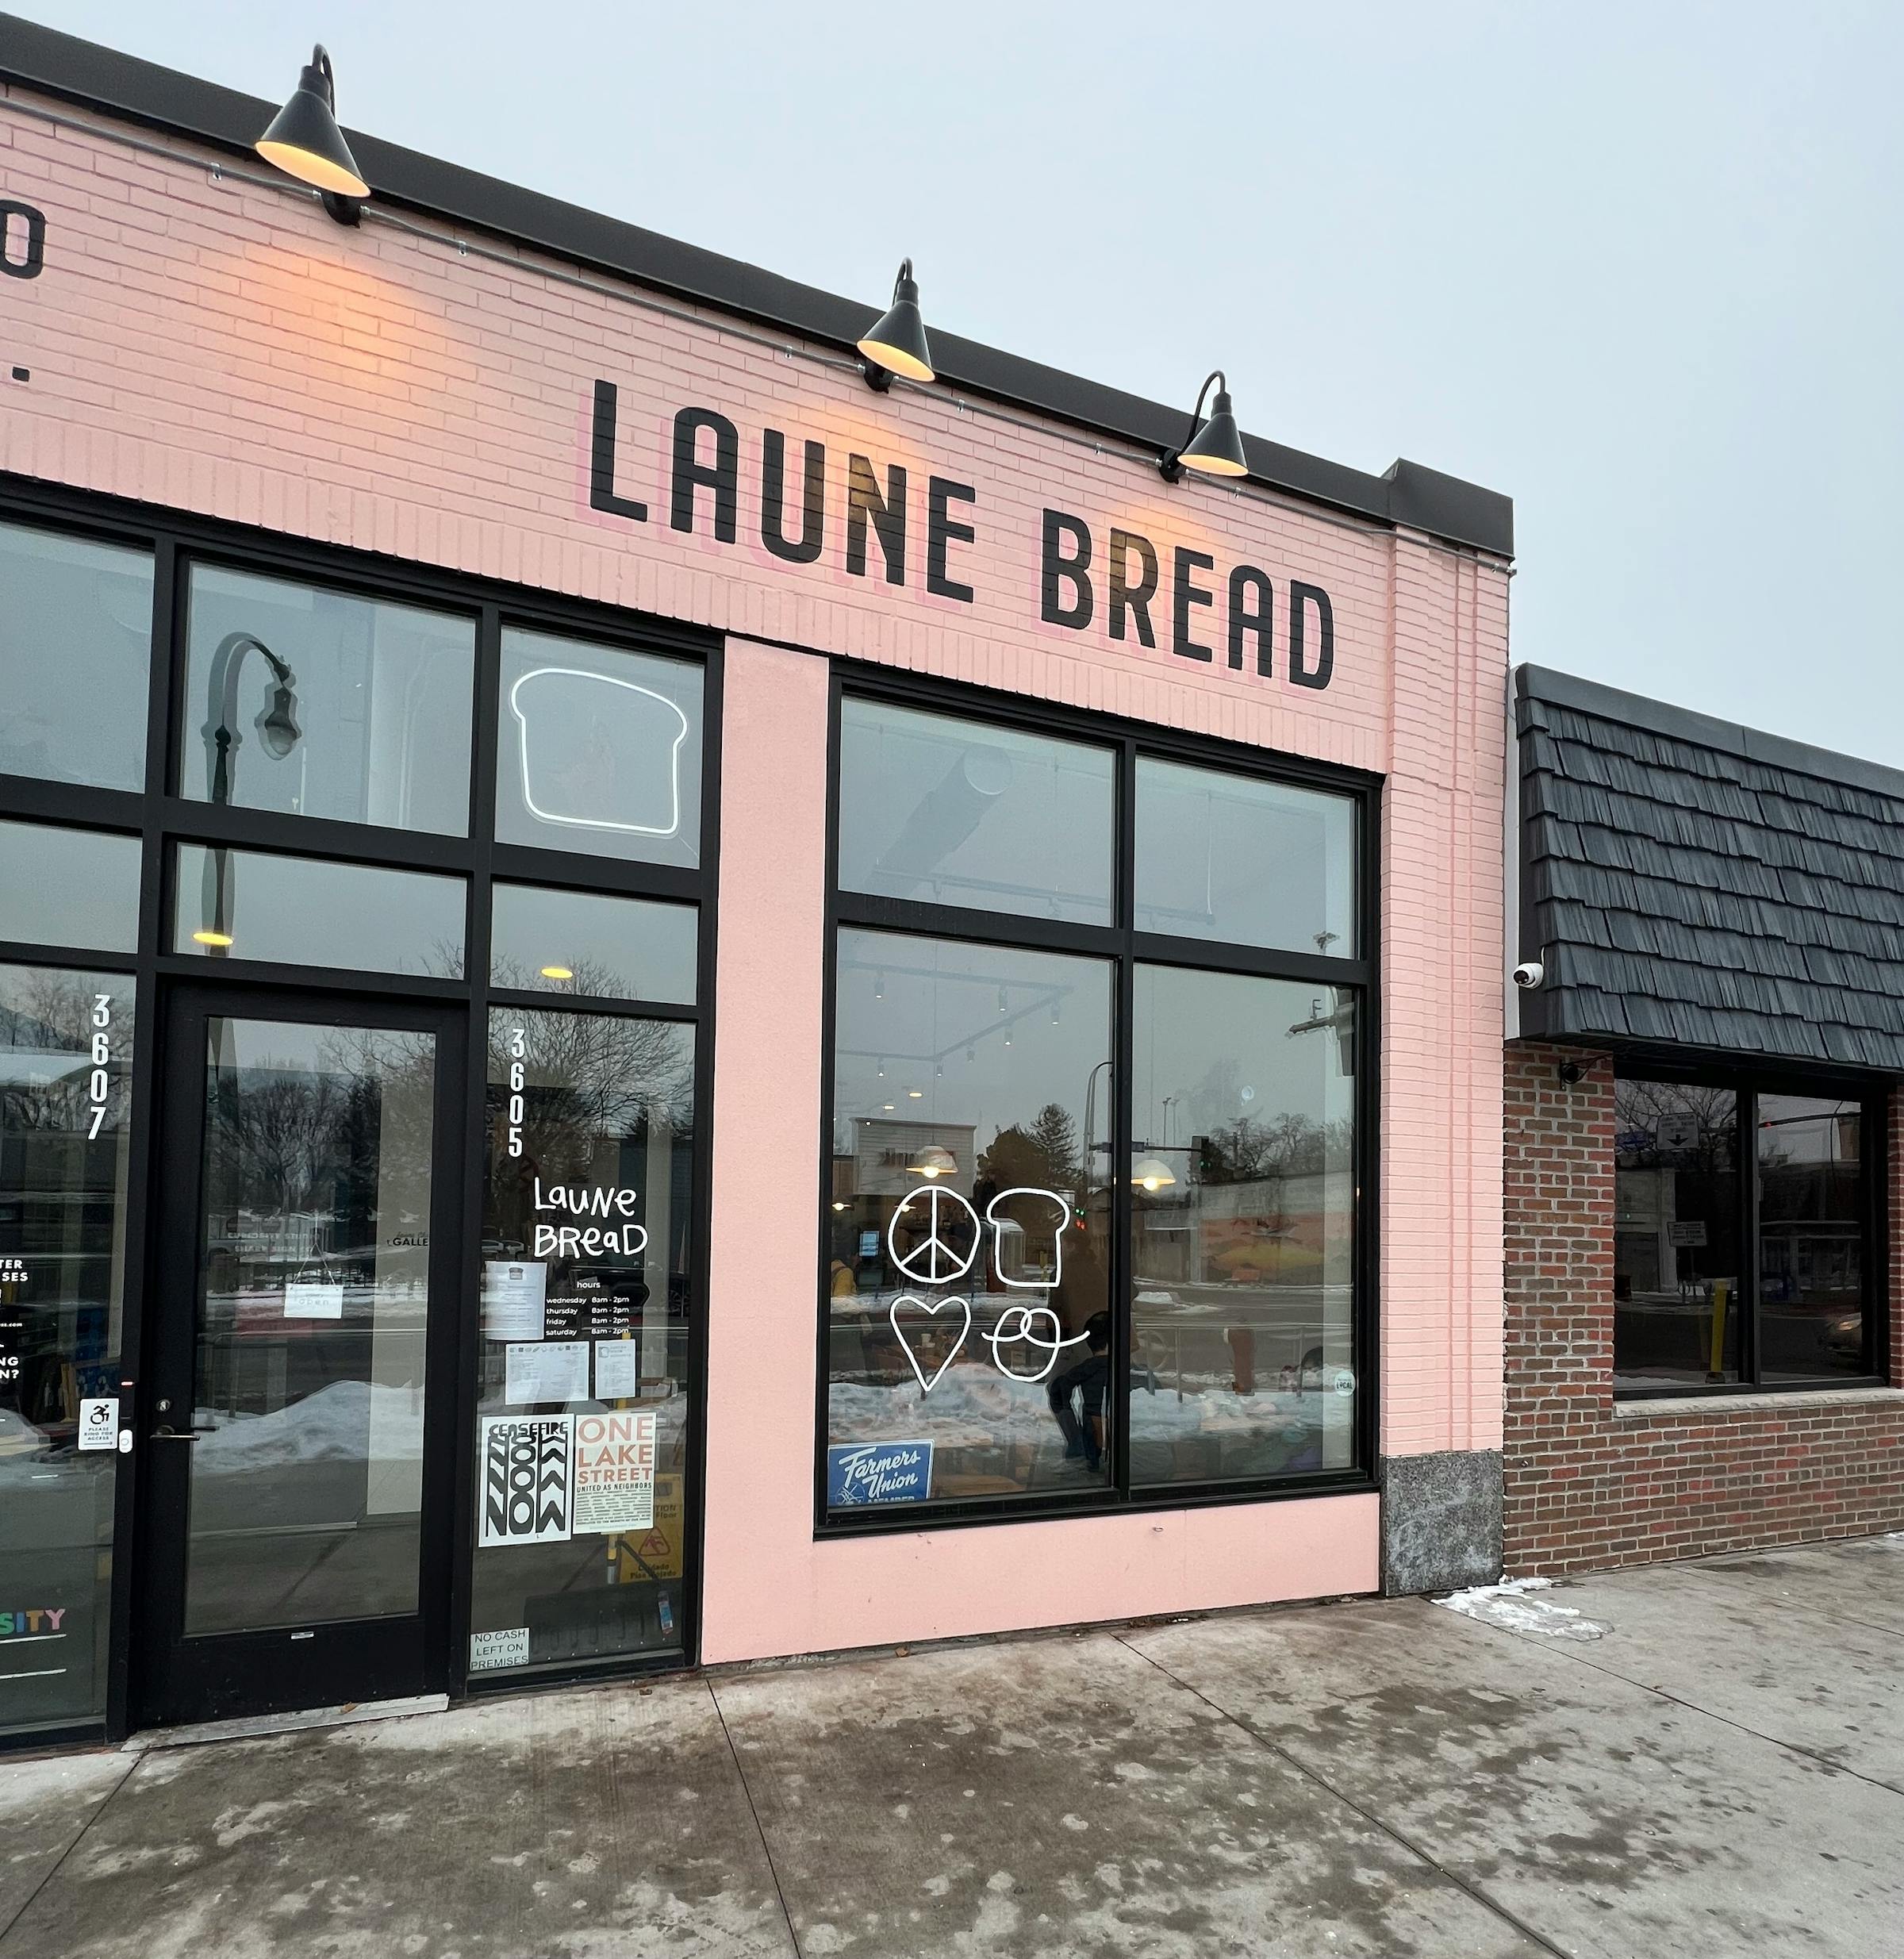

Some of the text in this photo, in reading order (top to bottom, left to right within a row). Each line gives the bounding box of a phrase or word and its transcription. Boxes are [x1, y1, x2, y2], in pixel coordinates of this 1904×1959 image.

[589, 378, 1334, 690] LAUNE BREAD
[87, 994, 110, 1140] 3607
[508, 1028, 525, 1158] 3605
[2, 1271, 29, 1282] SES
[576, 1281, 601, 1289] hours
[0, 1369, 20, 1379] N?
[489, 1422, 569, 1438] CEASEFIRE
[578, 1415, 654, 1444] ONE
[578, 1444, 653, 1468] LAKE
[578, 1467, 653, 1485] STREET
[838, 1446, 921, 1488] Farmers
[576, 1485, 601, 1493] UNITED
[613, 1481, 652, 1490] NEIGHBORS
[862, 1471, 919, 1498] Union
[486, 1492, 566, 1537] NOW
[0, 1608, 66, 1634] SITY
[474, 1630, 526, 1642] NO CASH
[476, 1642, 524, 1657] LEFT ON
[470, 1655, 529, 1670] PREMISES
